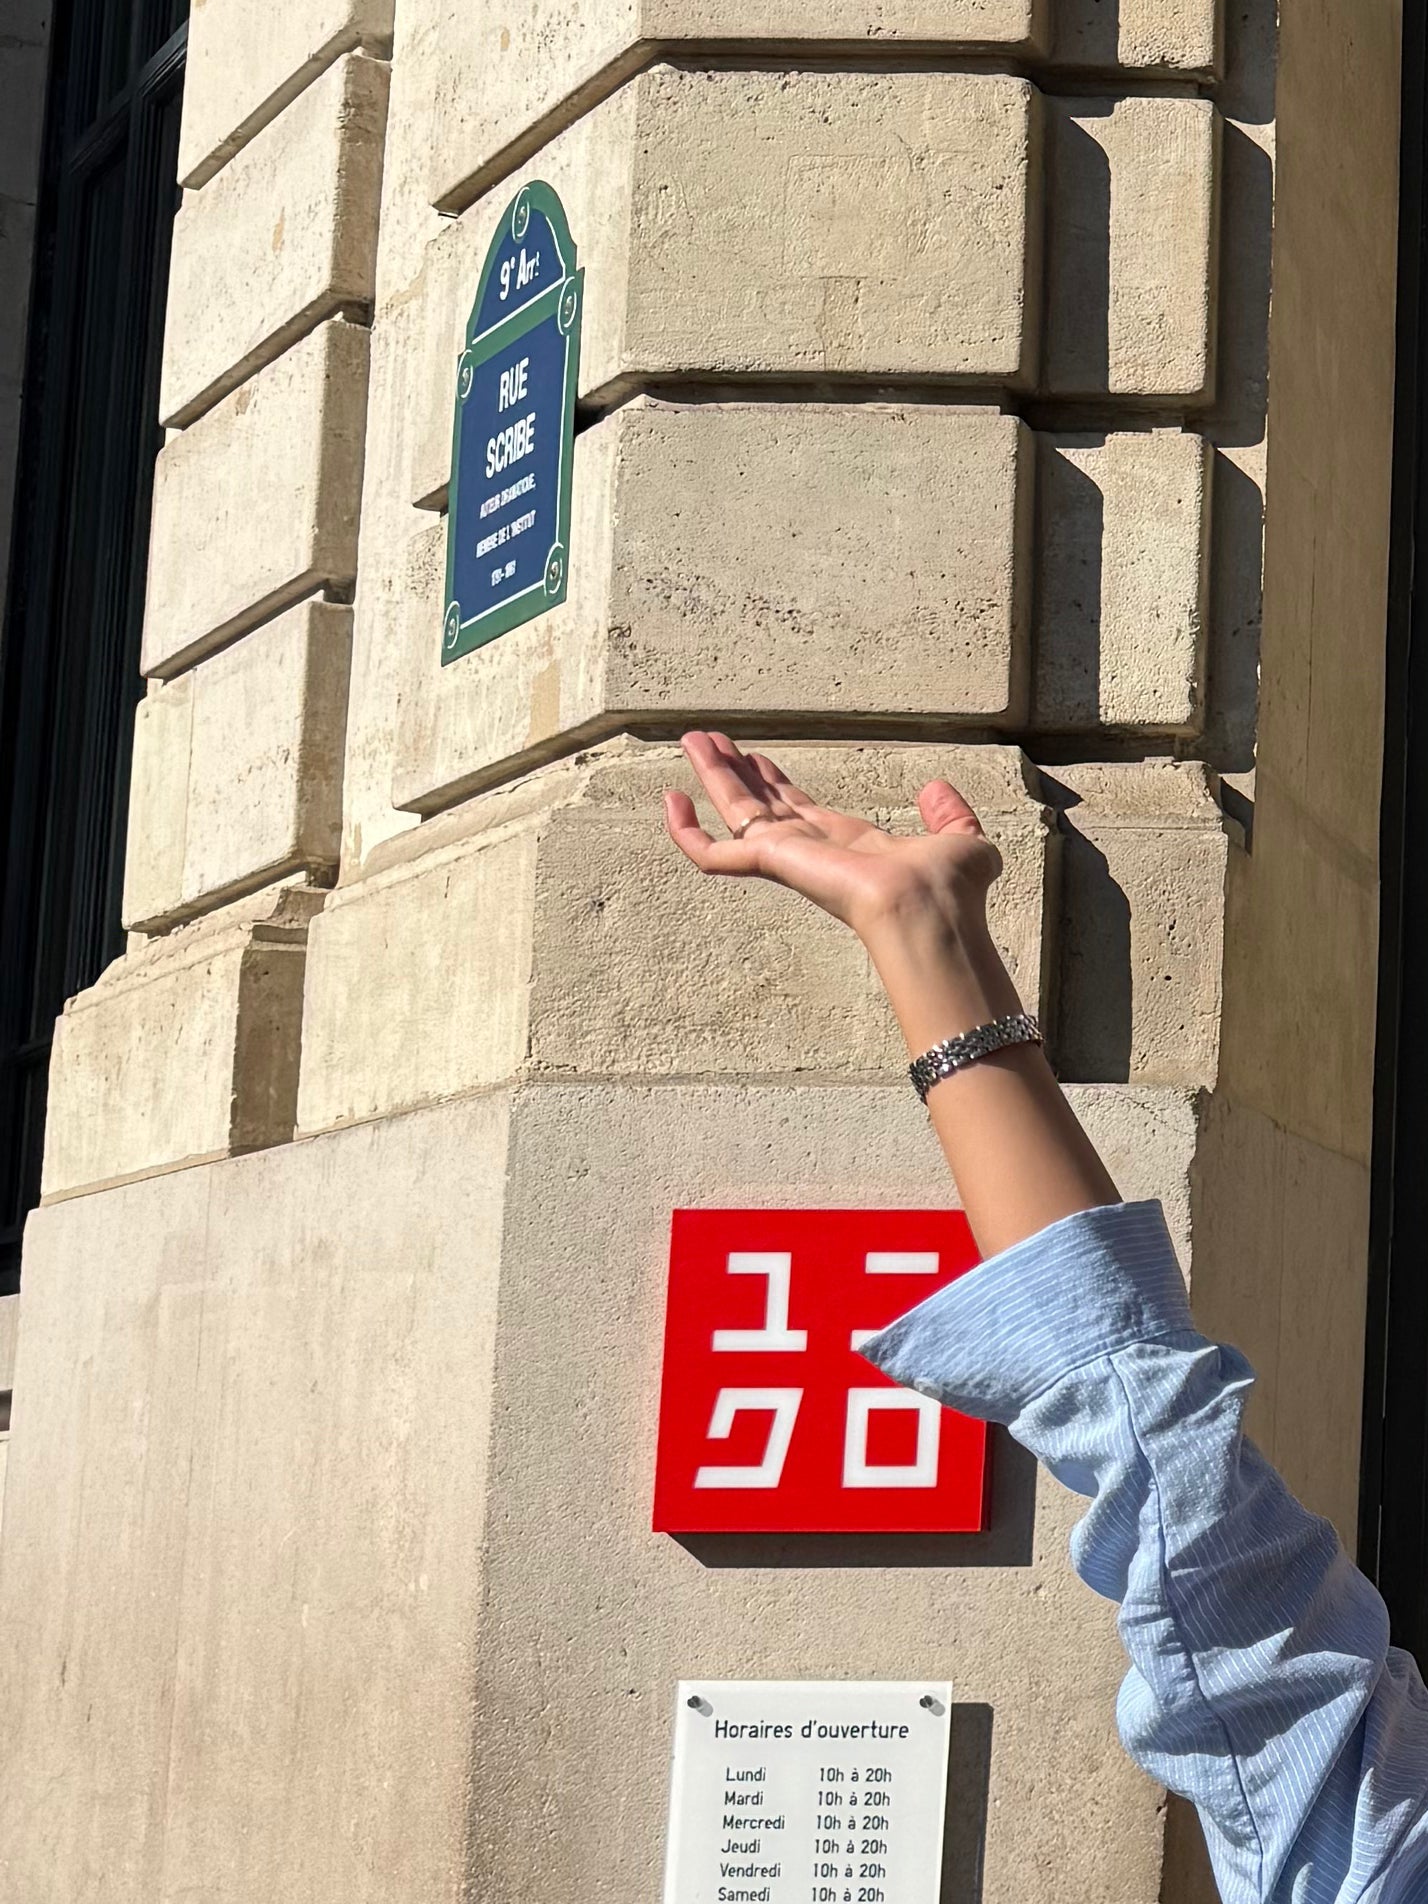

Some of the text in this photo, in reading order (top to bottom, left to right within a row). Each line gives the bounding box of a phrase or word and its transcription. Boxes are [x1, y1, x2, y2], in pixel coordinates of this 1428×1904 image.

[498, 356, 530, 413] RUE
[485, 412, 536, 480] SCRIBE
[692, 1387, 942, 1489] クロ
[715, 1720, 909, 1738] Horaires d'ouverture
[726, 1767, 891, 1782] Lundi 10h à 20h
[725, 1791, 890, 1806] Mardi 10h à 20h
[723, 1815, 888, 1830] Mercredi 10h à 20h
[721, 1839, 887, 1854] Jeudi 10h à 20h
[720, 1863, 885, 1878] Vendredi 10h à 20h
[719, 1887, 884, 1902] Samedi 10h à 20h
